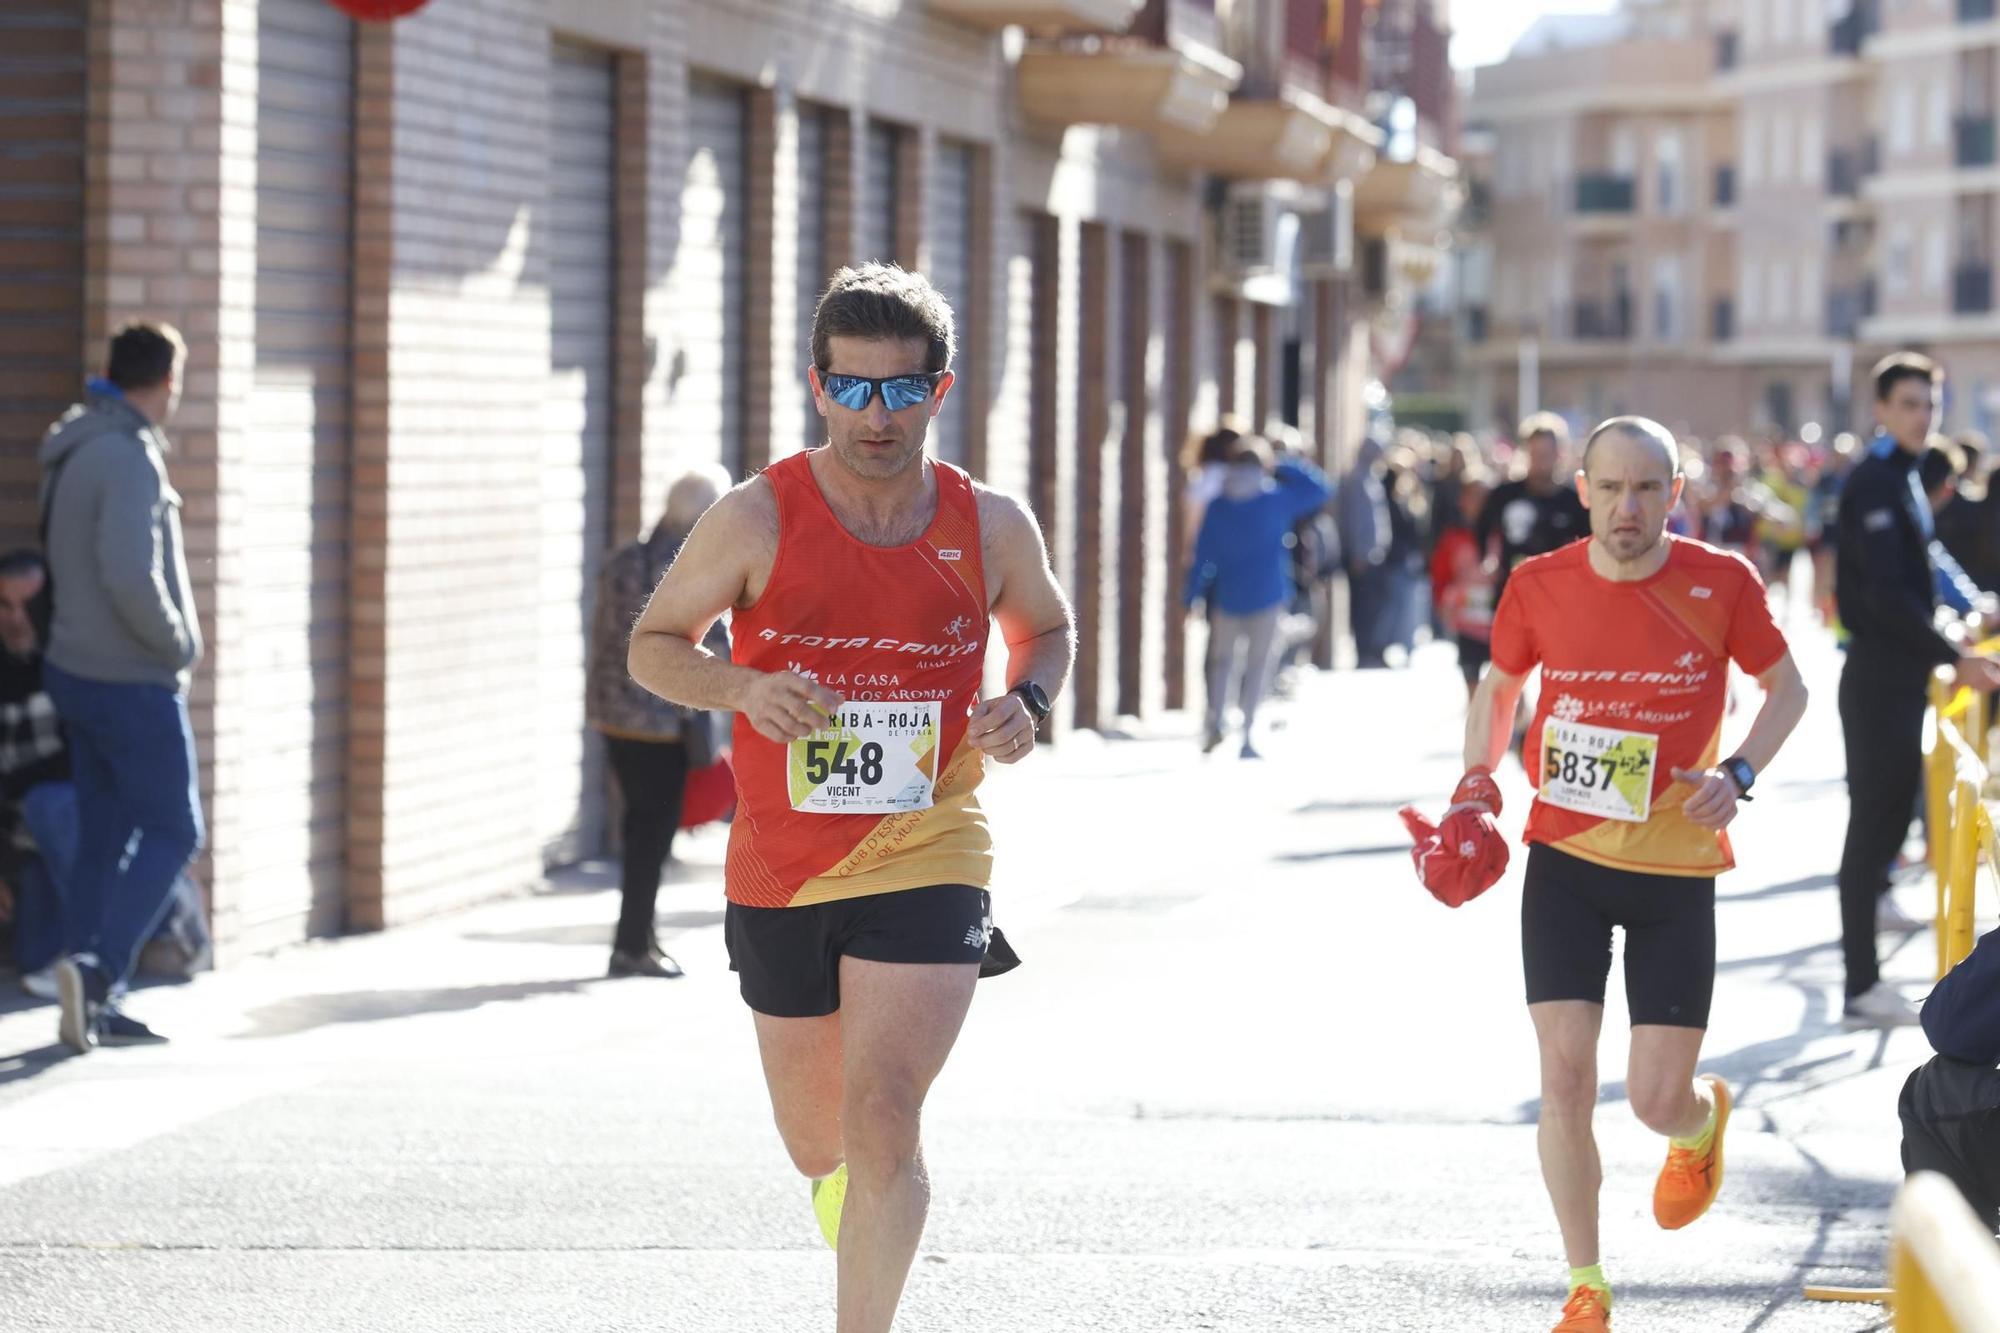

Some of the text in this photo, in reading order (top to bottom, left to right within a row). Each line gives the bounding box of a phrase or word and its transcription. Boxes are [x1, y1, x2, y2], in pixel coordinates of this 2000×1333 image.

[873, 638, 978, 657] CANYA
[826, 673, 900, 687] LA CASA
[851, 690, 883, 701] LOS
[887, 688, 954, 700] AROMAS
[888, 729, 899, 737] DE
[806, 741, 884, 785] 548
[1547, 746, 1617, 791] 5837
[826, 786, 861, 797] VICENT
[876, 842, 895, 858] DE
[838, 848, 868, 878] CLUB
